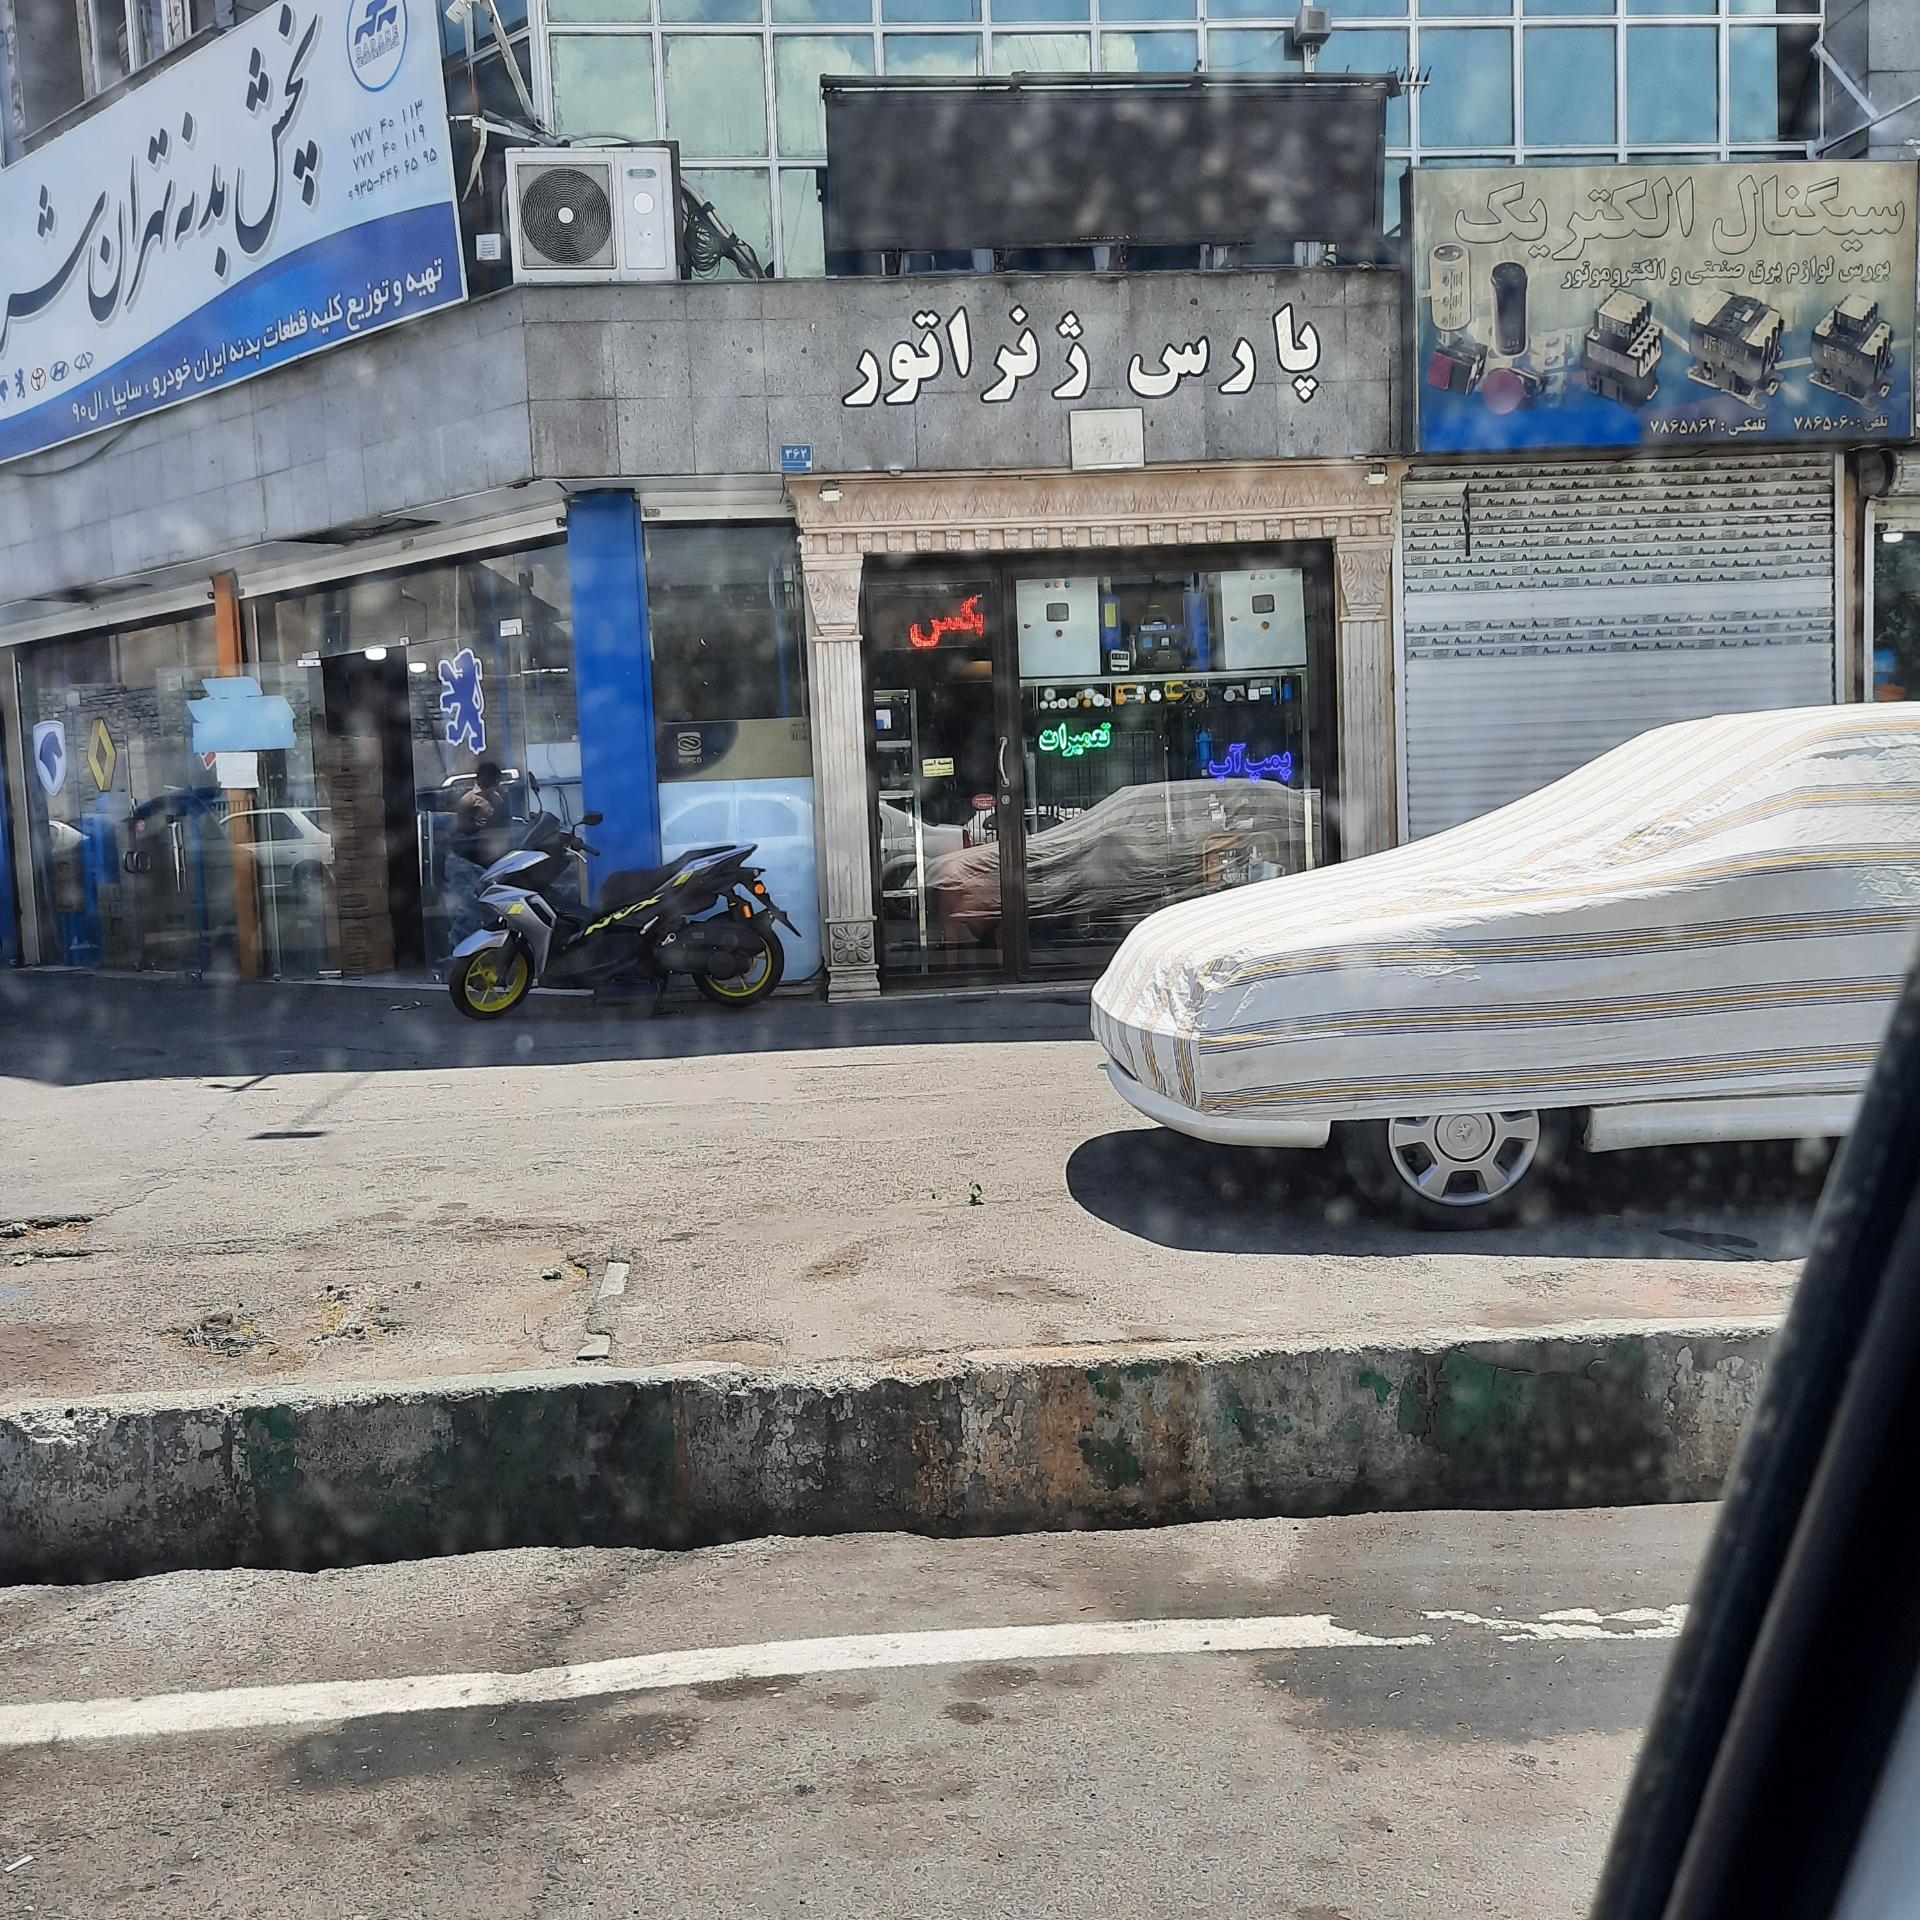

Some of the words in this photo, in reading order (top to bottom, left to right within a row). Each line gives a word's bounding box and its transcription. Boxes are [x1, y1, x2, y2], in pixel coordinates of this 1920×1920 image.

[235, 3, 318, 254] پخش
[350, 126, 371, 148] ۷۷۷
[380, 118, 393, 134] ۴۰
[402, 99, 422, 123] ۱۱۳
[353, 149, 373, 171] ۷۷۷
[382, 142, 396, 158] ۴۰
[405, 124, 424, 147] ۱۱۹
[404, 158, 418, 174] ۶۵
[423, 148, 437, 163] ۹۵
[175, 111, 227, 277] بدنه
[88, 128, 173, 322] تهران
[1455, 176, 1695, 260] الکتریک
[1712, 174, 1905, 255] سیگنال
[405, 258, 443, 297] تهیه
[1560, 257, 1666, 289] الکتروموتور
[1669, 266, 1681, 286] و
[1684, 260, 1746, 286] صنعتی
[1749, 260, 1783, 285] برق
[1786, 255, 1835, 285] لوازم
[1838, 260, 1891, 283] بورس
[346, 279, 389, 331] توزیع
[393, 280, 403, 307] و
[263, 309, 308, 348] قطعات
[311, 293, 344, 334] کلیه
[193, 343, 227, 383] ایران
[229, 333, 261, 361] بدنه
[840, 304, 1091, 408] ژنراتور
[1127, 303, 1322, 402] پارس
[784, 447, 808, 460] ۳۶۲
[1038, 722, 1112, 757] تعمیرات
[1209, 743, 1246, 782] آب
[1244, 751, 1292, 784] پمپ
